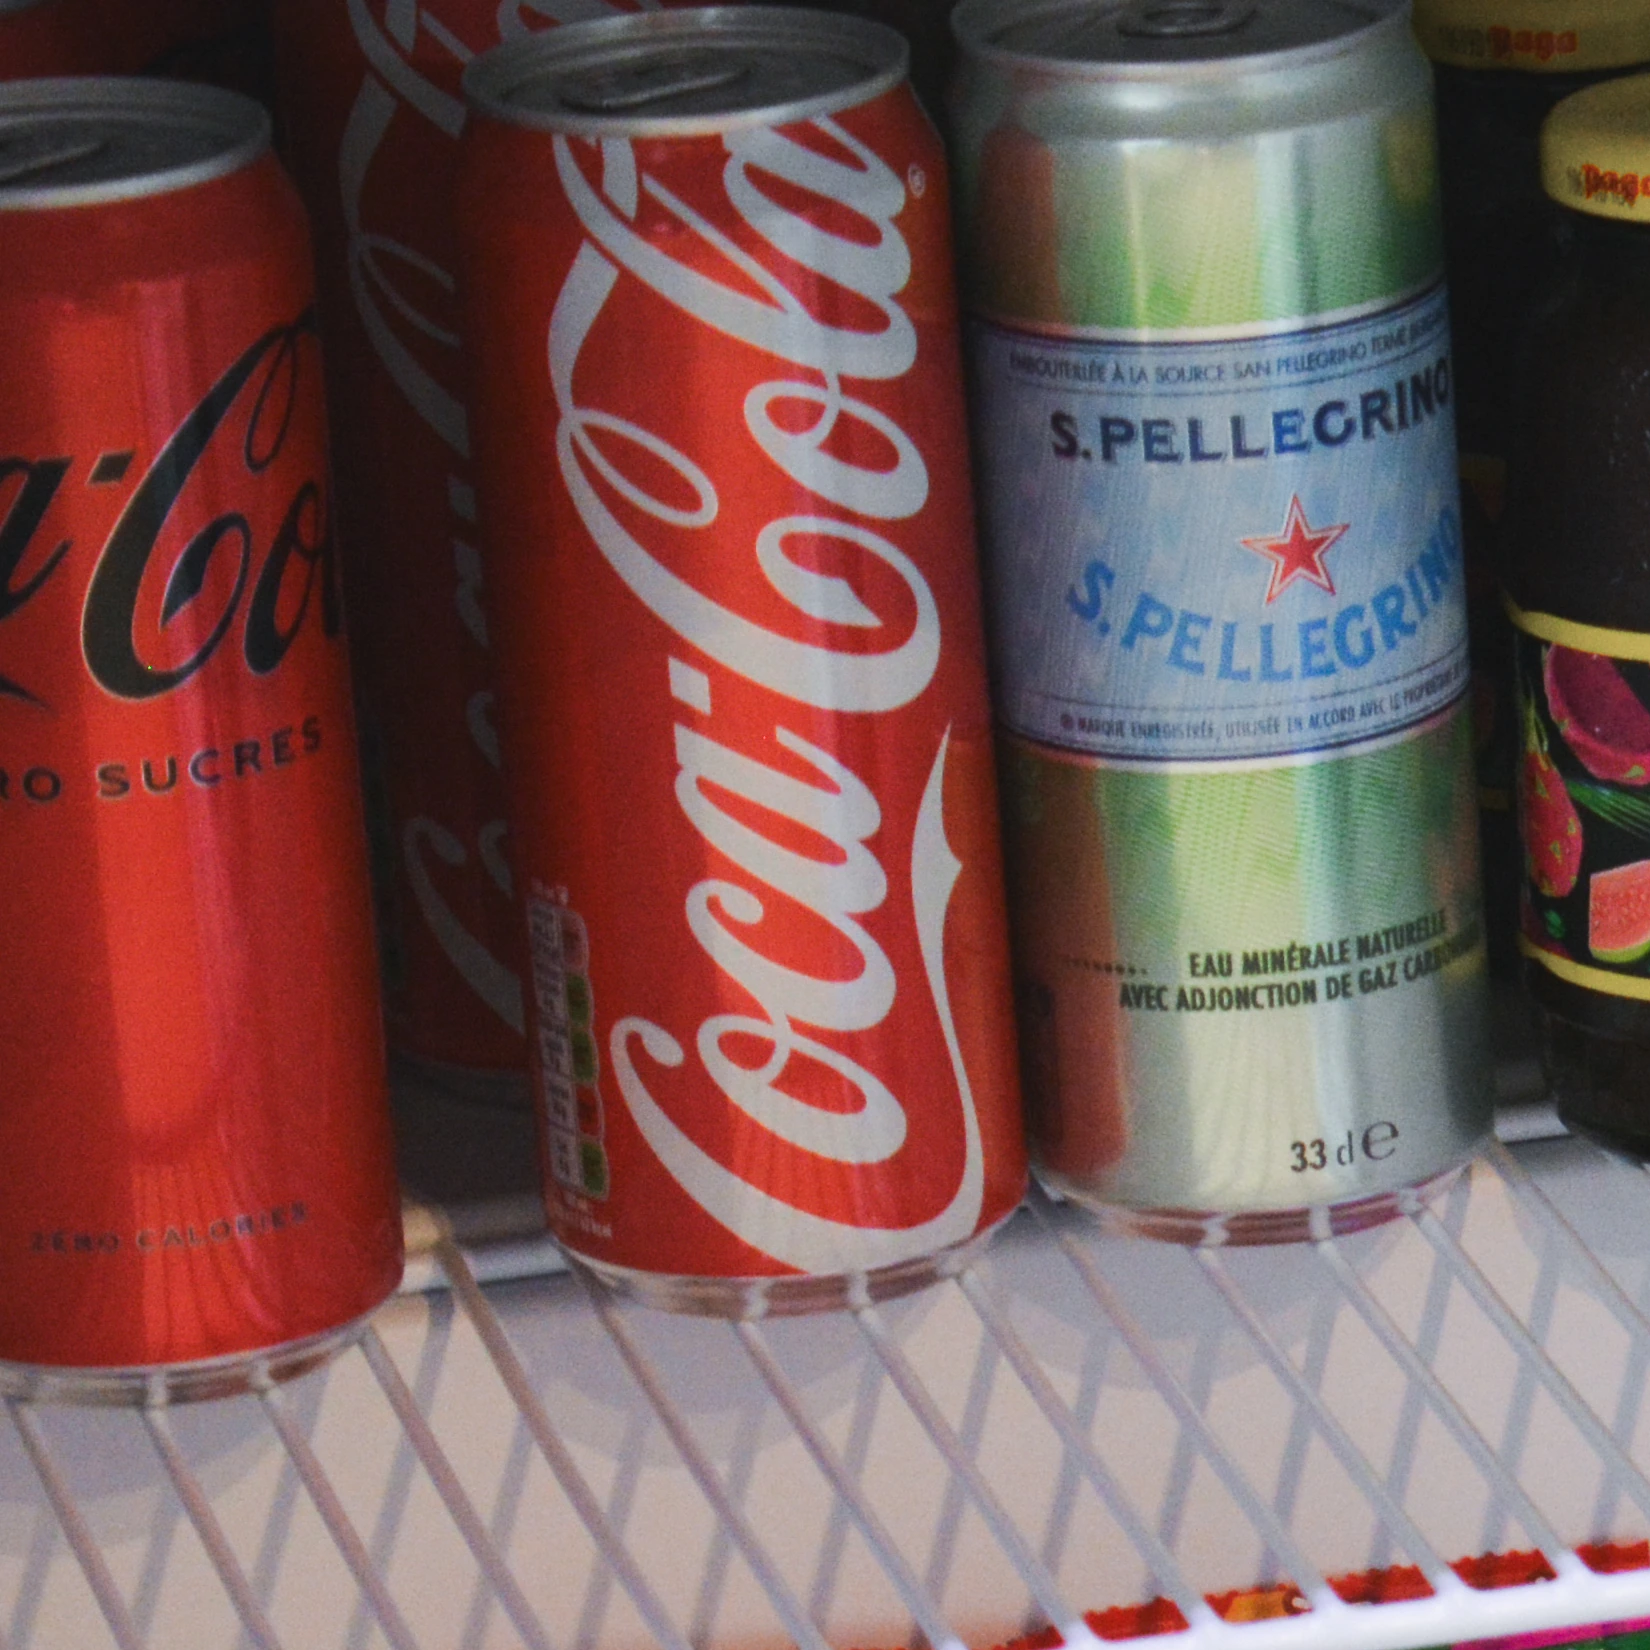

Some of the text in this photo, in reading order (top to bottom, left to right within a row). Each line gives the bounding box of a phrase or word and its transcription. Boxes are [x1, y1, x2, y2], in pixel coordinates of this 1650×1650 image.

[1487, 24, 1579, 62] pago
[1130, 363, 1149, 385] LA
[1156, 363, 1224, 385] SOURCE
[1232, 359, 1272, 380] SAN
[1276, 341, 1368, 376] PELLEGRINO
[547, 110, 986, 1276] Coca-Cola
[1308, 704, 1356, 731] ACCORD
[1360, 698, 1386, 719] AVEC
[96, 716, 324, 801] SUCRES
[1188, 951, 1233, 979] EAU
[1241, 937, 1351, 976] MINÉRALE
[1356, 908, 1446, 961] NATURELLE
[1118, 983, 1169, 1012] AVEC
[1175, 977, 1318, 1012] ADJONCTION
[1325, 974, 1353, 1000] DE
[1358, 960, 1399, 996] GAZ
[1290, 1137, 1328, 1174] 33
[1336, 1129, 1356, 1167] cl
